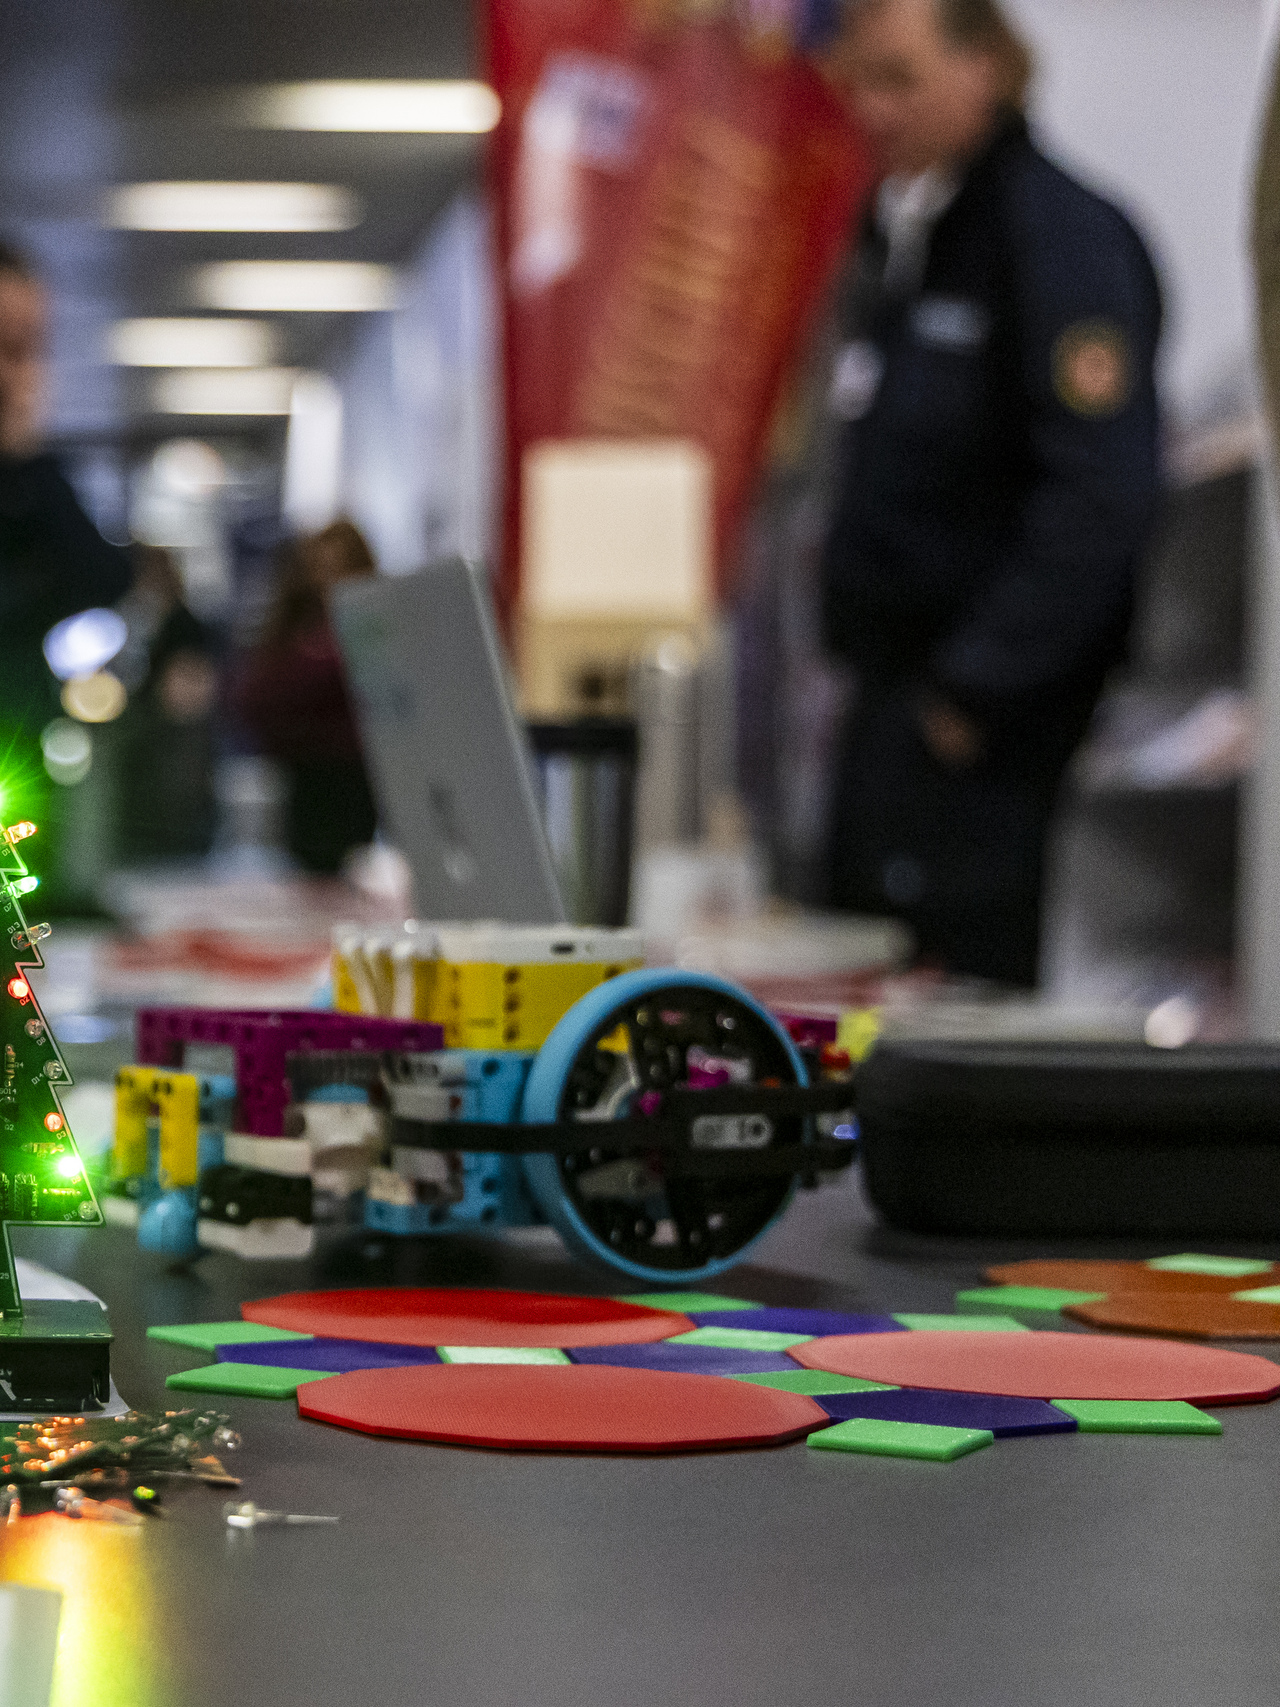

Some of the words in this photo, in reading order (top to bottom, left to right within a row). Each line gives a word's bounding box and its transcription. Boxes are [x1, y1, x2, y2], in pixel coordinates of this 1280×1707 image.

[1, 848, 11, 857] D1
[3, 902, 12, 912] D7
[7, 921, 21, 934] D13
[20, 996, 30, 1006] D2
[36, 1036, 47, 1046] D8
[56, 1130, 66, 1140] D3
[63, 1209, 78, 1221] D15
